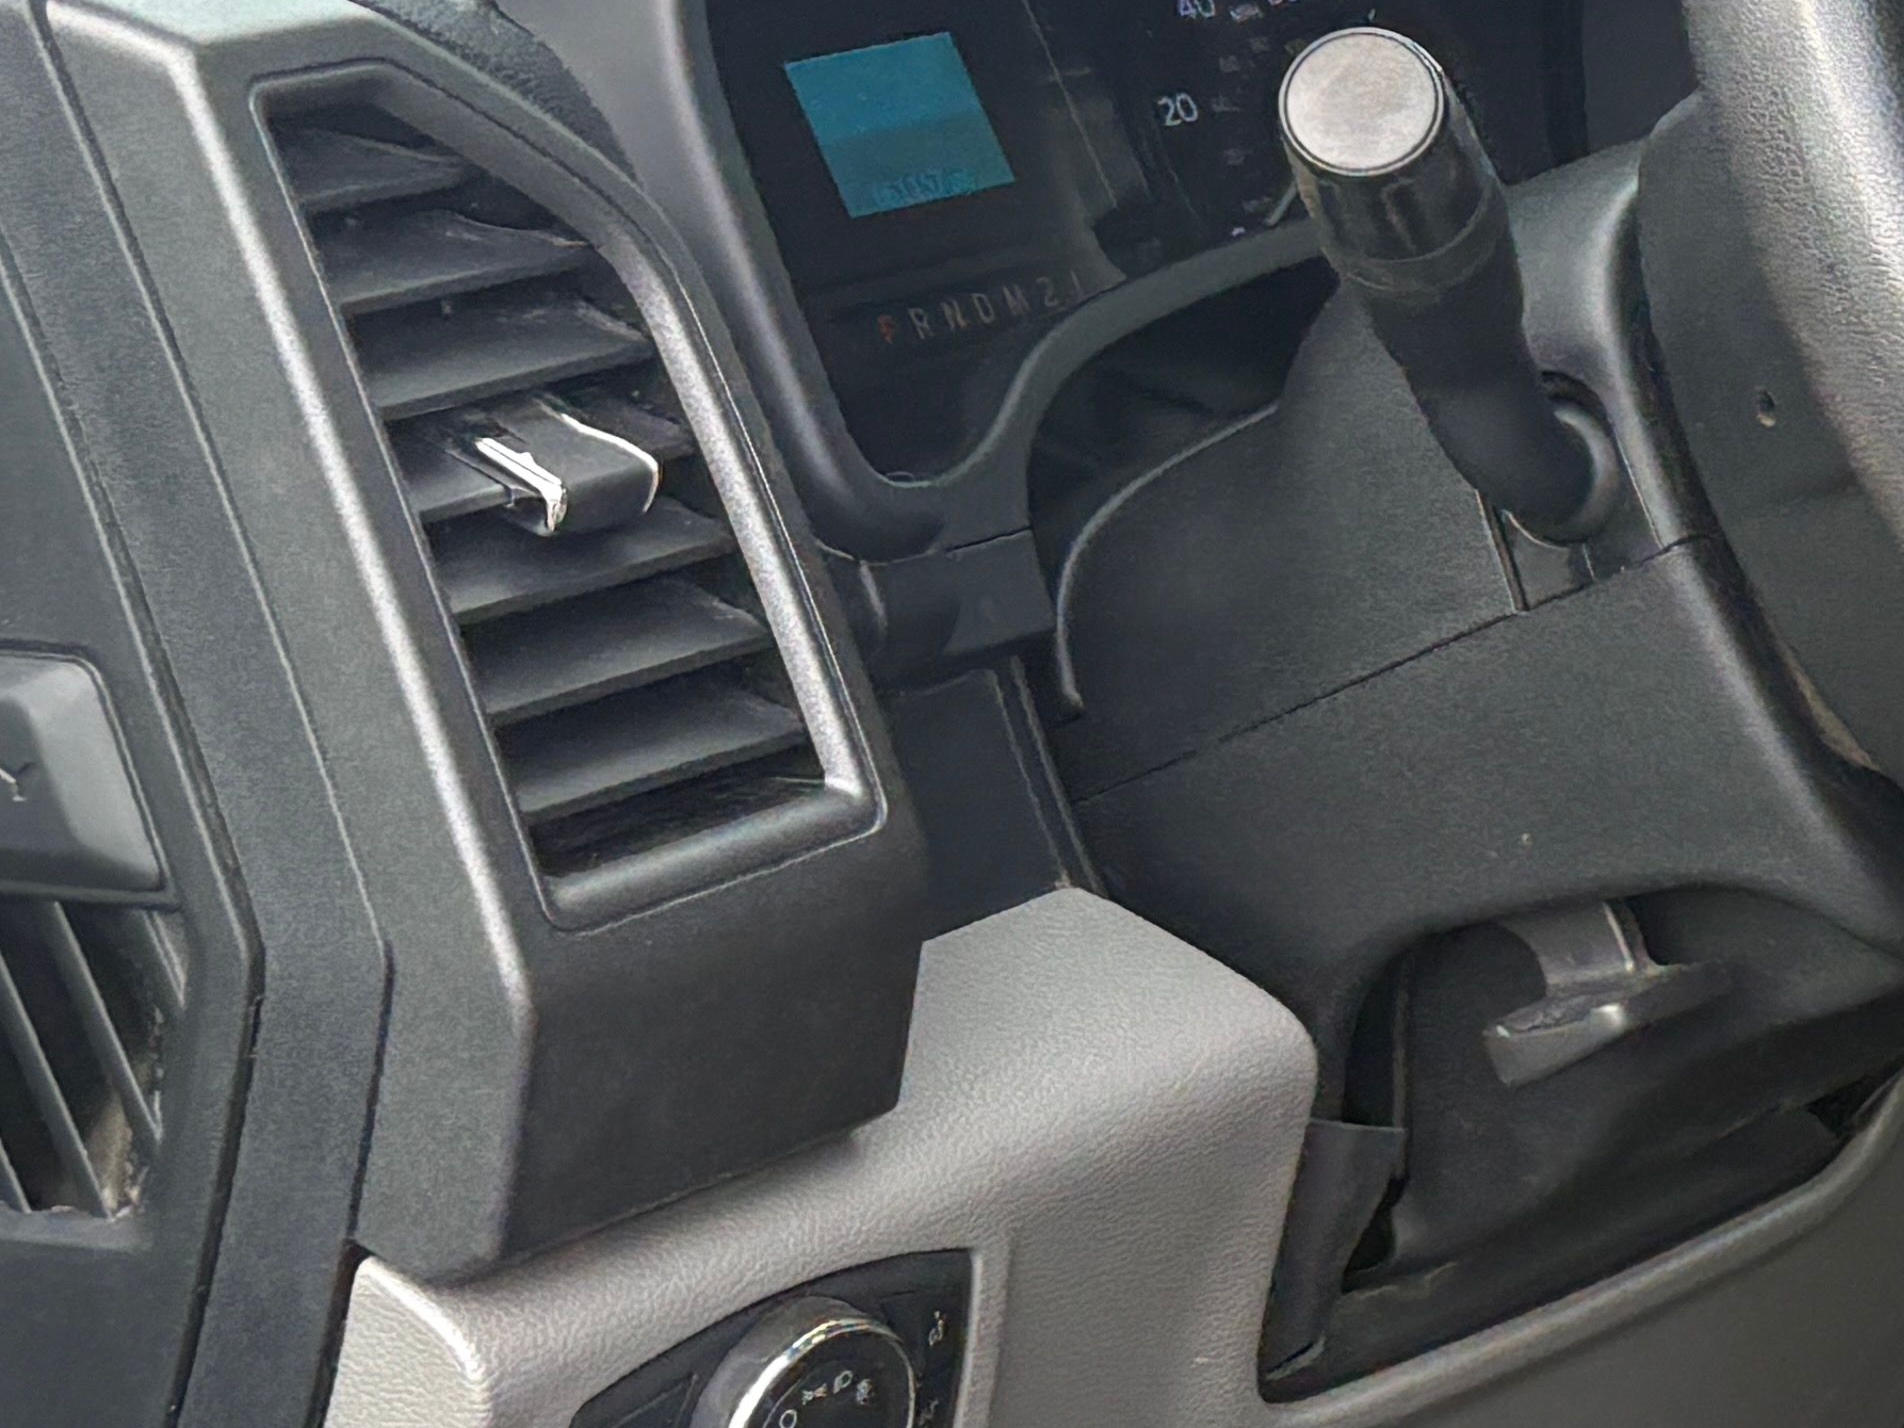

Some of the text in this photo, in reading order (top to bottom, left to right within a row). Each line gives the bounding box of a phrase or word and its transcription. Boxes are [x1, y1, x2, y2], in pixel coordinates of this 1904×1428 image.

[1158, 92, 1199, 126] 20
[908, 307, 935, 339] R
[971, 292, 996, 323] D
